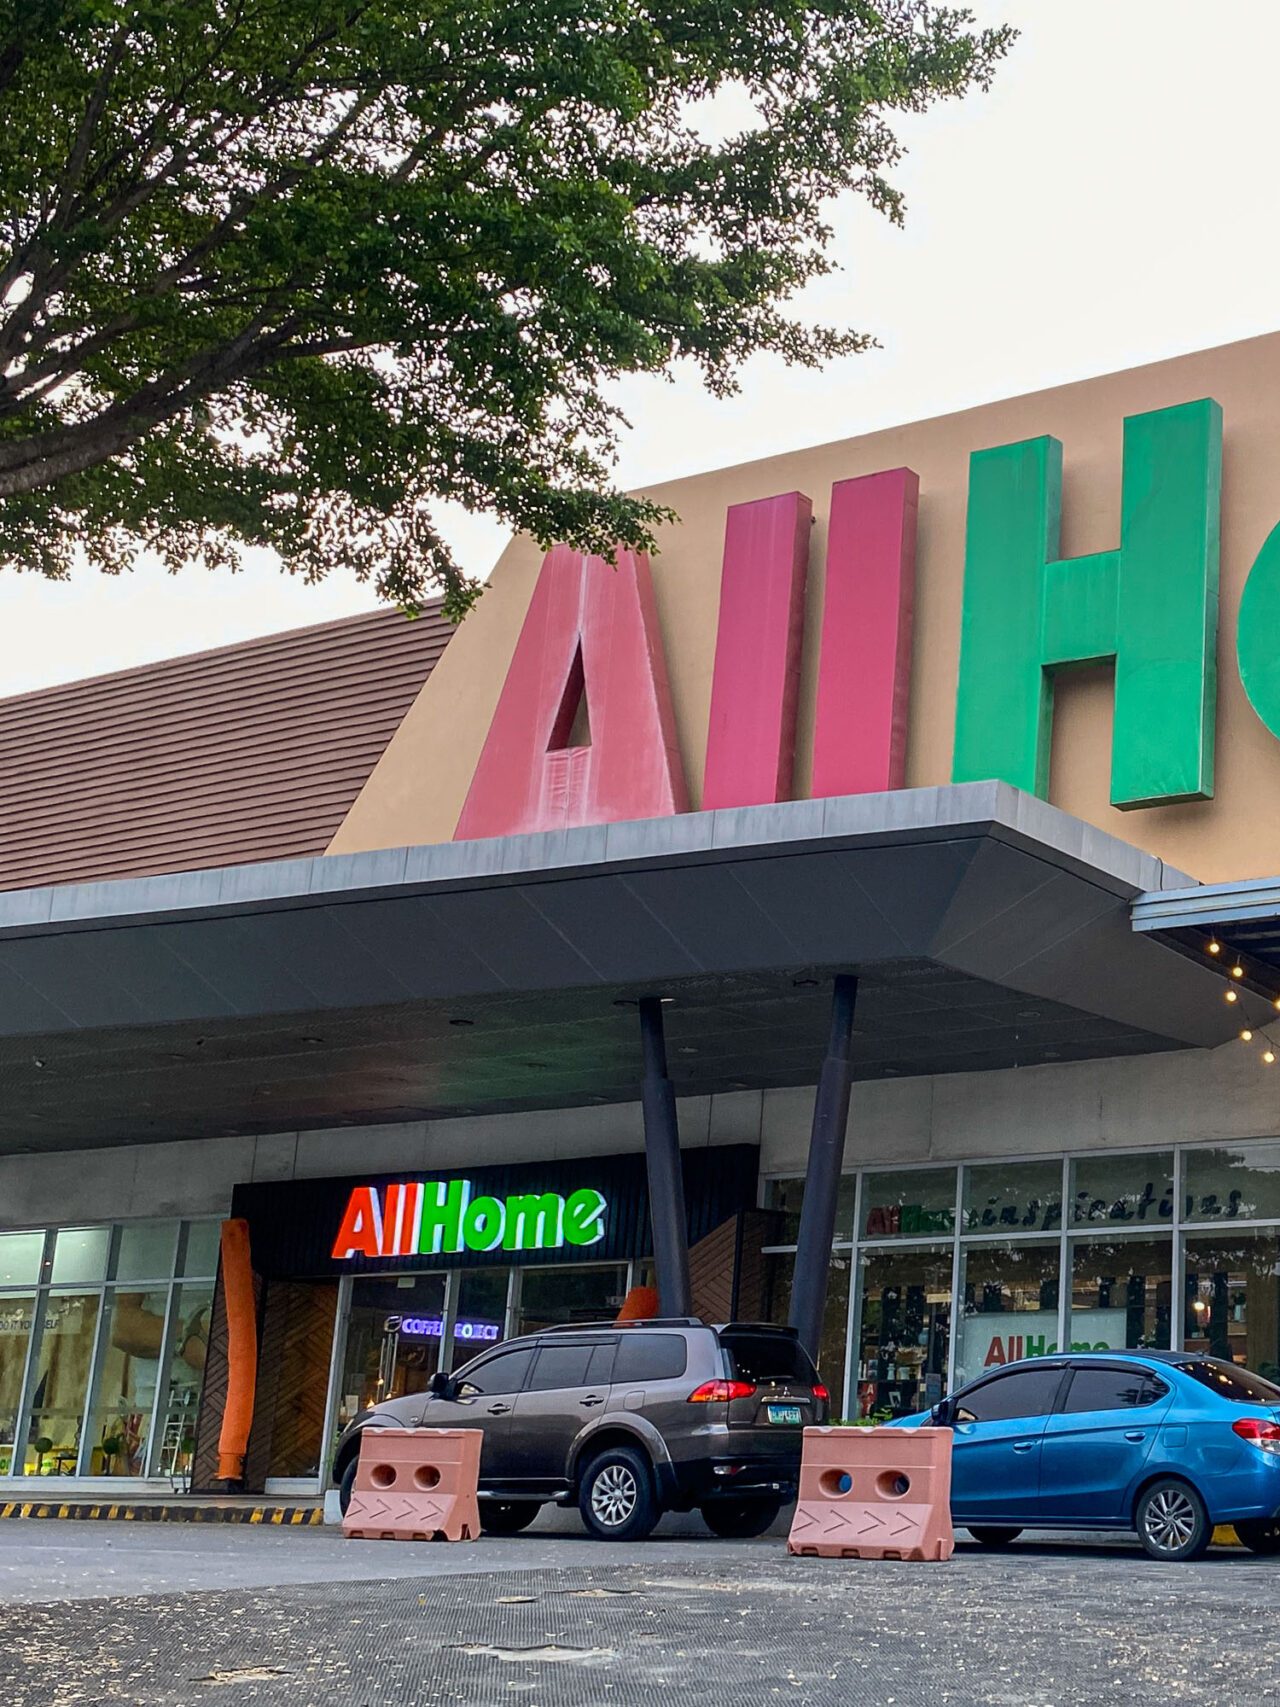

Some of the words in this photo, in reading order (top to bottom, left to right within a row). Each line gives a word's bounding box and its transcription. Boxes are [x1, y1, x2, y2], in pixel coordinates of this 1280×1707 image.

[331, 1179, 608, 1259] AllHome
[402, 1318, 443, 1336] COFFE
[984, 1334, 1110, 1367] AllH
